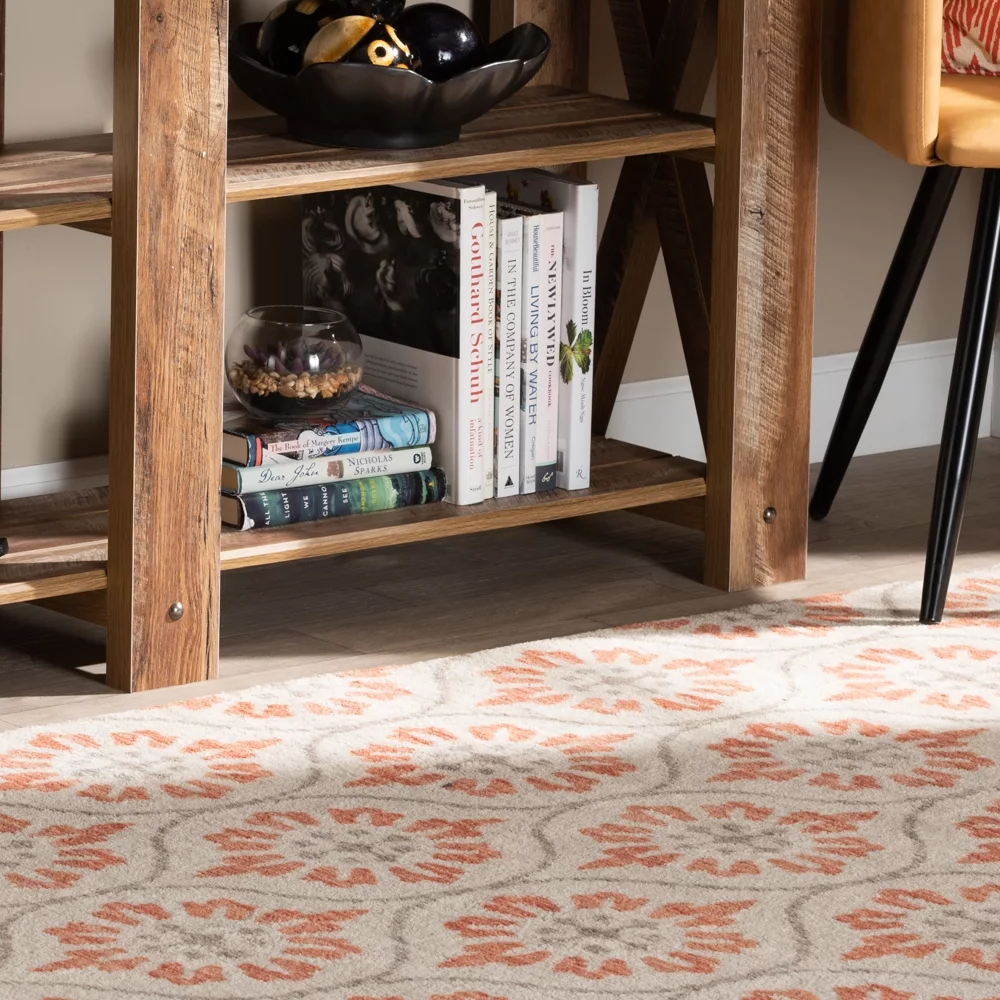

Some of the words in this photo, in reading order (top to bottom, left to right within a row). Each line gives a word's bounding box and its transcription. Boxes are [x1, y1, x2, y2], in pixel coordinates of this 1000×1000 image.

[488, 204, 496, 238] HOUSE
[488, 241, 495, 250] &
[471, 222, 484, 325] Gotthard
[507, 258, 517, 274] IN
[582, 270, 592, 283] In
[506, 277, 517, 308] THE
[530, 285, 540, 338] LIVING
[546, 260, 557, 366] NEWLYWED
[581, 286, 592, 326] Bloom
[487, 328, 494, 340] OF
[504, 312, 516, 379] COMPANY
[529, 343, 539, 364] BY
[470, 333, 484, 404] Schuh
[504, 383, 515, 402] OF
[527, 369, 538, 426] WATER
[271, 444, 284, 453] The
[285, 441, 302, 451] Book
[302, 439, 310, 448] of
[310, 436, 336, 448] Margery
[337, 434, 359, 445] Kempe
[469, 419, 477, 471] infatuation
[503, 405, 515, 460] WOMEN
[347, 454, 393, 467] NICHOLAS
[477, 449, 484, 459] of
[258, 467, 285, 484] Dear
[286, 462, 319, 487] John
[353, 464, 388, 477] SPARKS
[259, 491, 269, 507] THE
[280, 492, 290, 519] LIGHT
[303, 495, 309, 509] WE
[320, 485, 329, 517] CANNO
[341, 487, 349, 504] SEE
